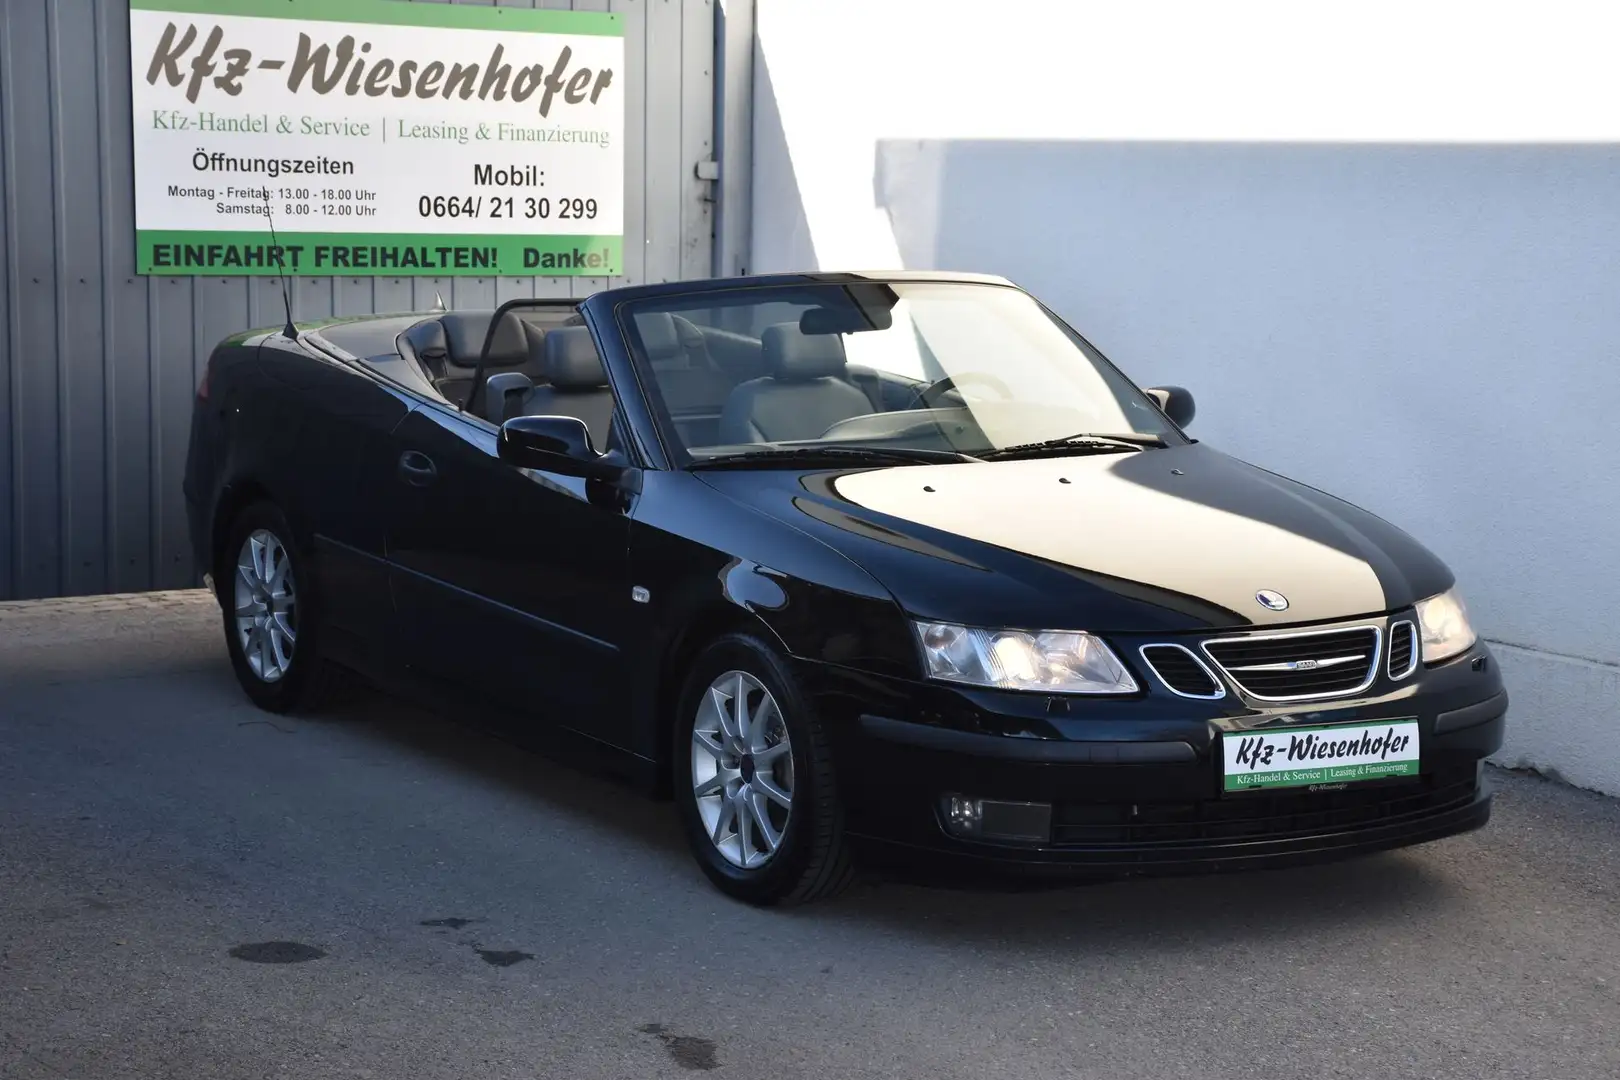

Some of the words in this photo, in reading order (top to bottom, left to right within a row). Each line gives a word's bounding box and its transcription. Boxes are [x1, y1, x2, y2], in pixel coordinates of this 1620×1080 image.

[146, 21, 613, 118] Kfz-Wiesenhofer
[152, 110, 269, 134] Kfz-Handel
[276, 116, 293, 134] &
[300, 117, 370, 137] Service
[398, 119, 469, 143] Leasing
[475, 124, 491, 141] &
[497, 123, 610, 147] Finanzierung
[192, 148, 354, 177] Öffnungszeiten
[473, 163, 545, 187] Mobil:
[168, 185, 215, 201] Montag
[227, 187, 274, 202] Freitag:
[278, 188, 310, 200] 13.00
[321, 189, 352, 201] 18.00
[355, 189, 376, 202] Uhr
[216, 202, 274, 217] Samstag:
[285, 204, 310, 216] 8.00
[321, 204, 352, 216] 12.00
[355, 204, 376, 216] Uhr
[419, 197, 482, 218] 0664/
[490, 197, 515, 218] 21
[524, 197, 551, 219] 30
[558, 198, 598, 219] 299
[153, 245, 304, 268] EINFAHRT
[314, 246, 498, 268] FREIHALTEN!
[523, 248, 609, 269] Danke!
[1236, 728, 1409, 769] Kfz-Wiesenhofer
[1237, 773, 1281, 784] Kfz-Handel
[1283, 772, 1291, 780] &
[1293, 771, 1320, 780] Service
[1331, 768, 1356, 778] Leasing
[1365, 763, 1408, 774] Finanzierung
